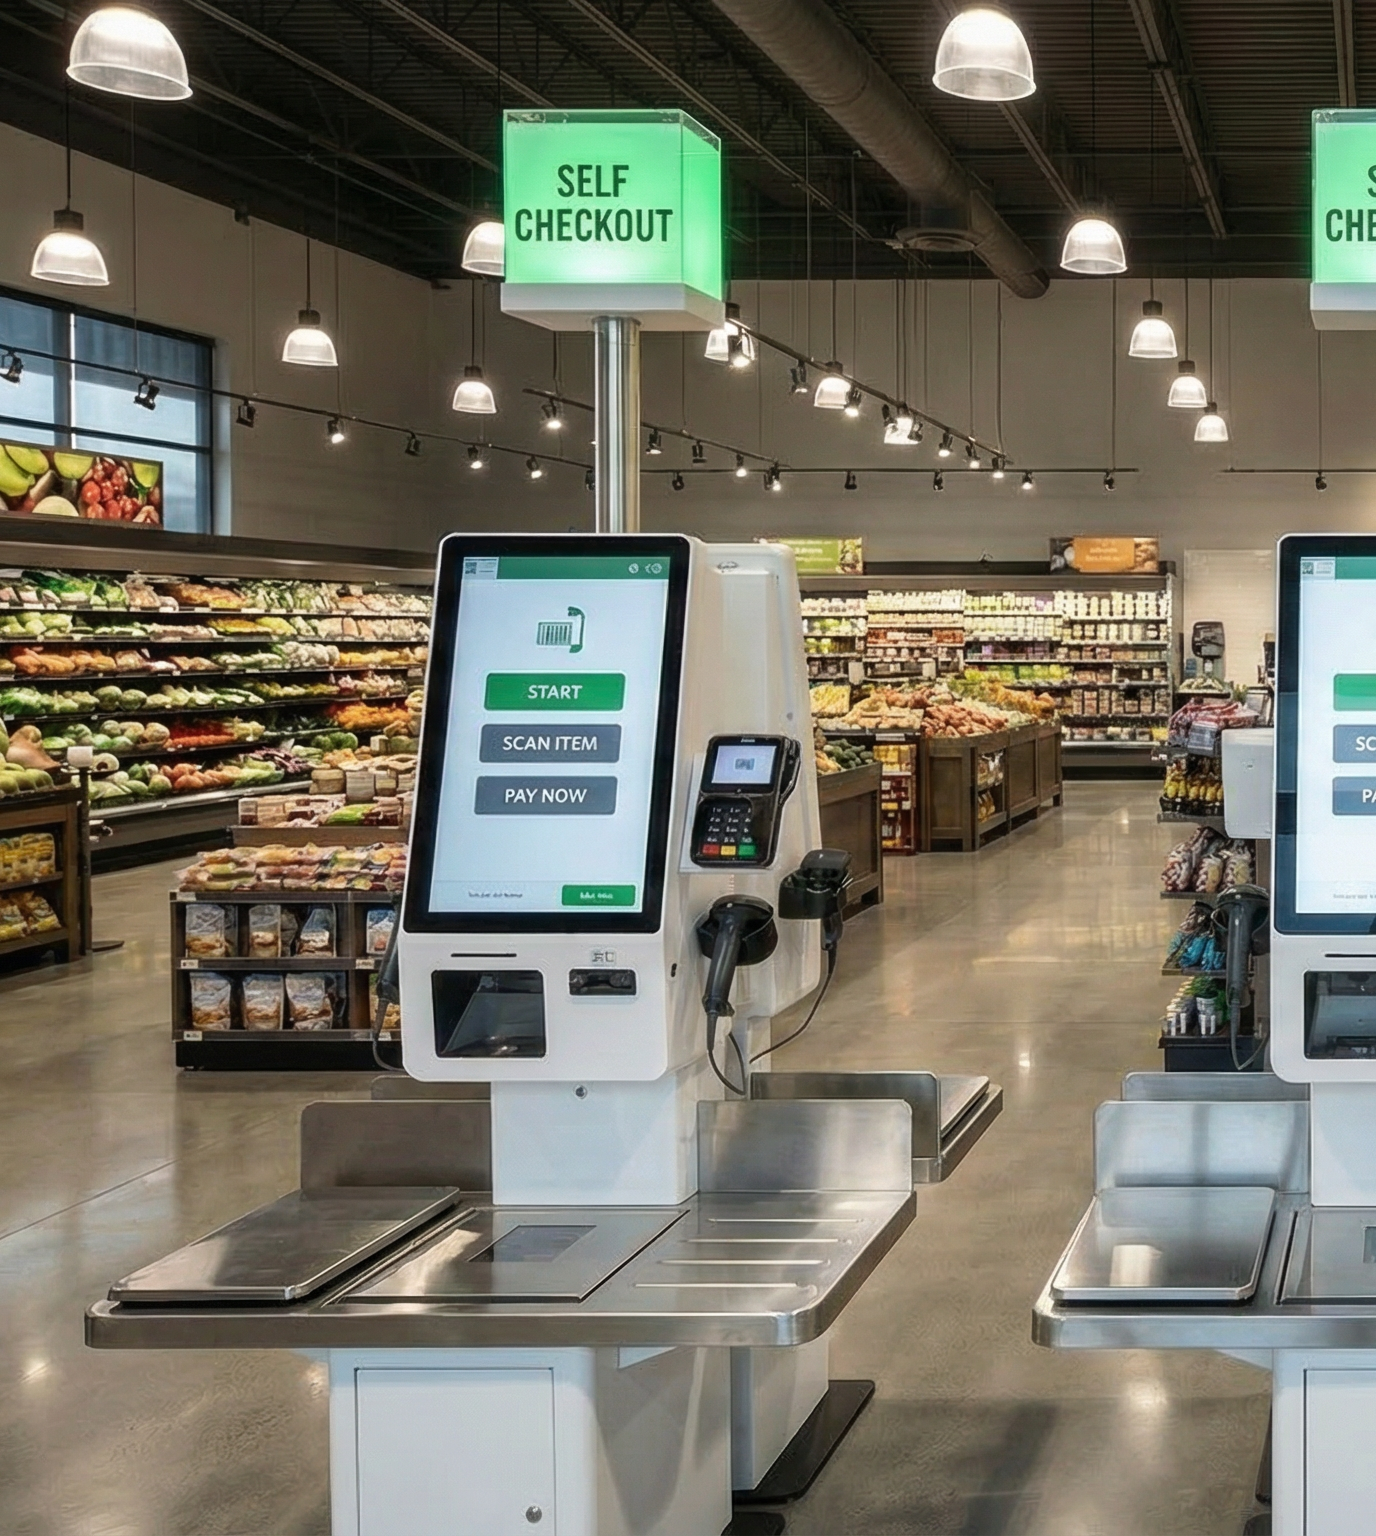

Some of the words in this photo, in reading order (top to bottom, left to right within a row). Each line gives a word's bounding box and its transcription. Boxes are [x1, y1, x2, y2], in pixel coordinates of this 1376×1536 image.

[557, 163, 630, 198] SELF
[514, 208, 674, 242] CHECKOUT
[527, 684, 583, 700] START
[502, 735, 551, 751] SCAN
[555, 735, 598, 751] ITEM
[505, 788, 538, 804] PAY
[541, 788, 588, 804] NOW
